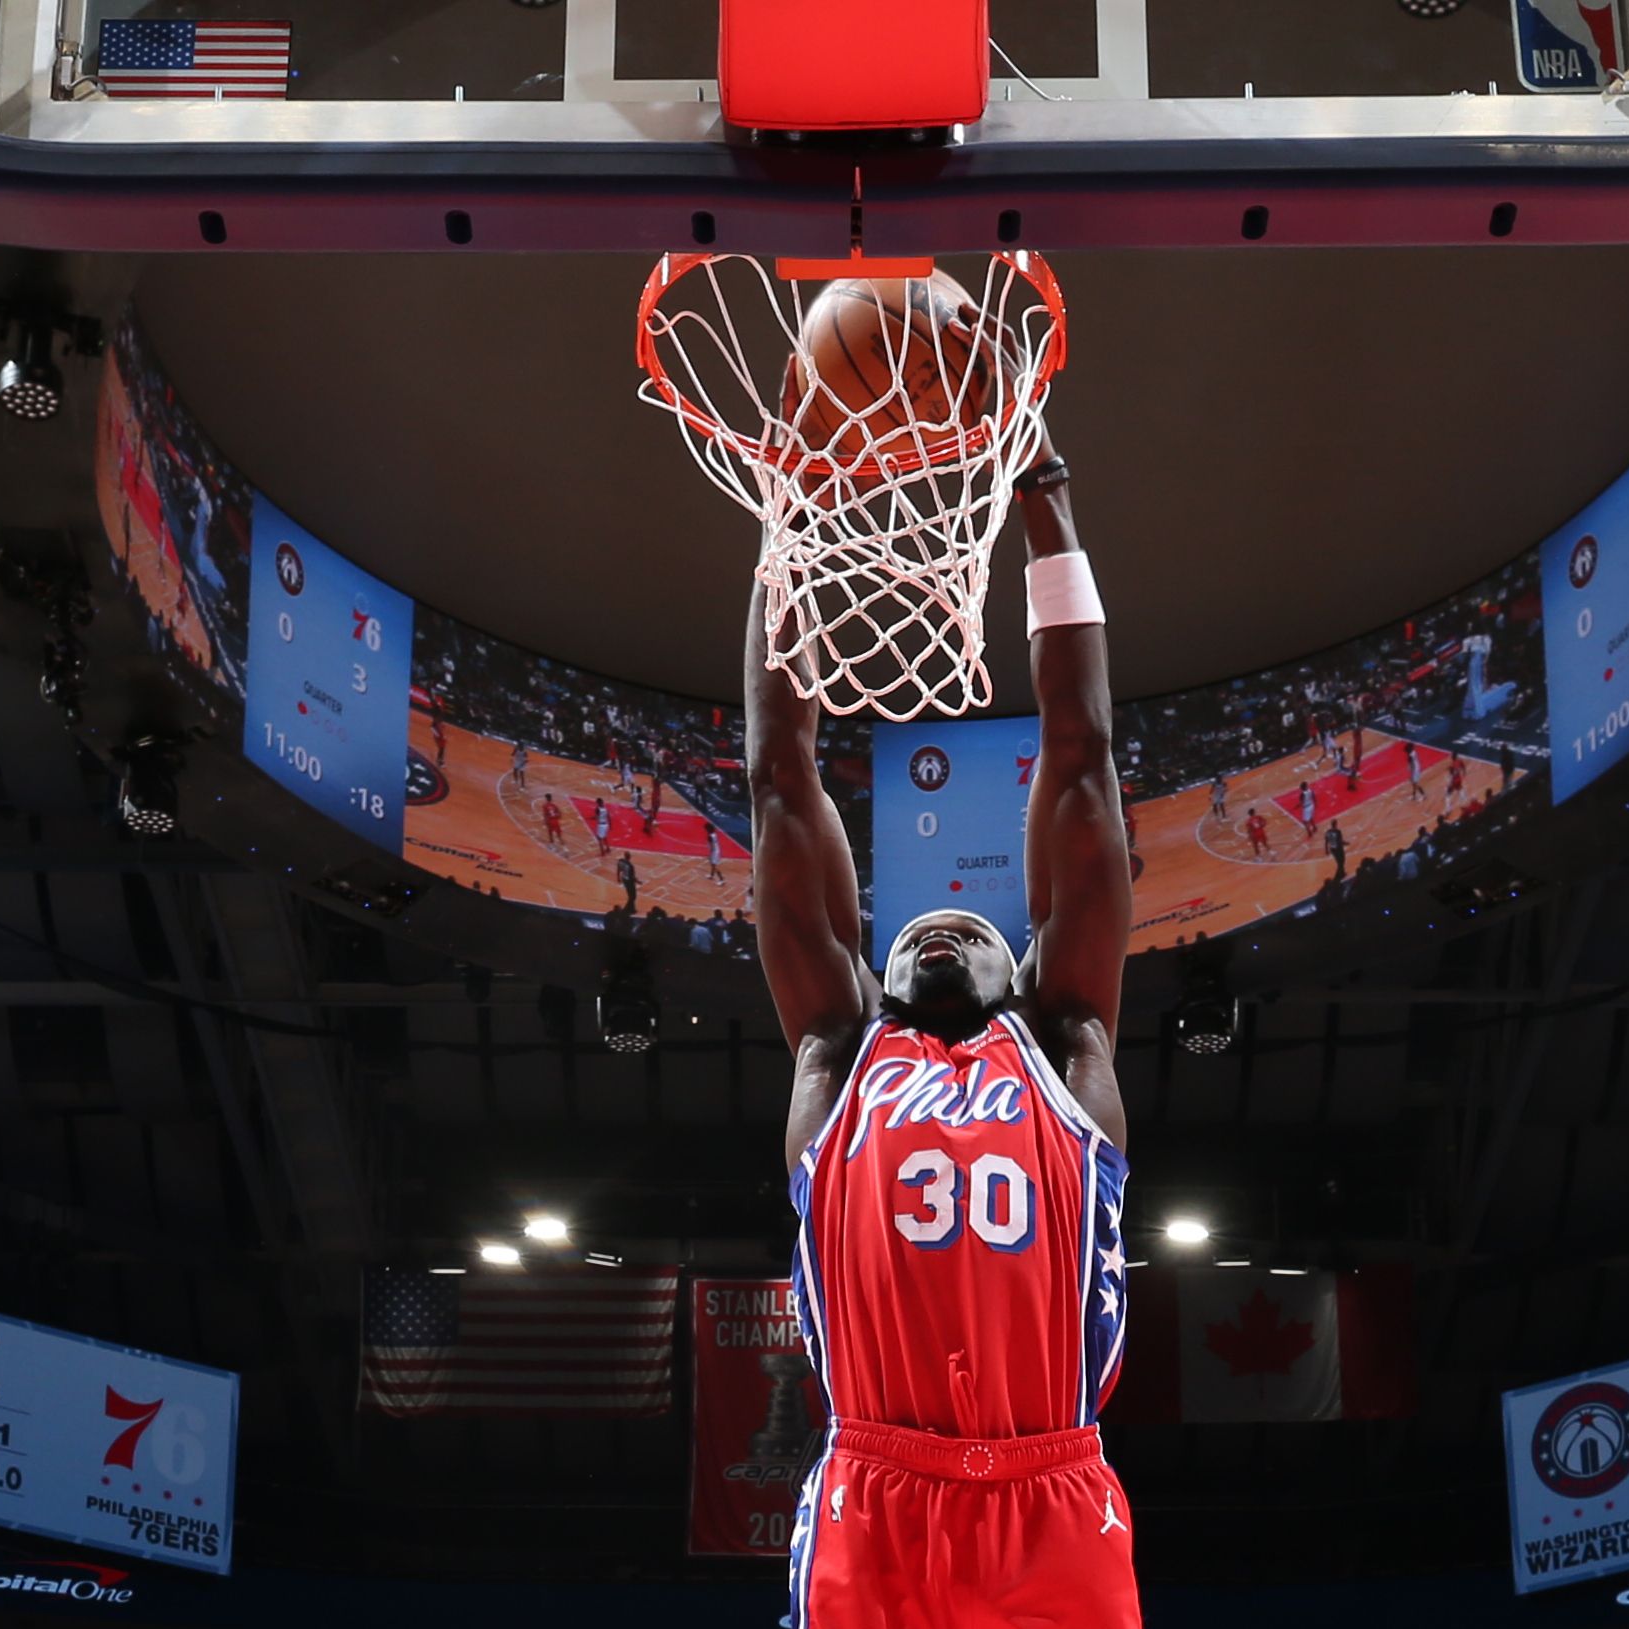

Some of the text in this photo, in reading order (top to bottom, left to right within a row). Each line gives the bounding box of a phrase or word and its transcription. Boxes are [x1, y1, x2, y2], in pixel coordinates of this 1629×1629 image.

[1532, 48, 1582, 79] NBA
[279, 612, 294, 643] 0
[351, 608, 381, 651] 76
[1577, 607, 1593, 638] 0
[352, 663, 367, 694] 3
[264, 722, 322, 782] 11:00
[351, 786, 385, 819] :18
[916, 811, 939, 838] 0
[956, 855, 1010, 871] QUARTER
[846, 1056, 1027, 1161] Phila
[893, 1148, 1036, 1254] 30
[705, 1288, 796, 1317] STANLE
[715, 1320, 803, 1348] CHAMP
[103, 1383, 206, 1485] 76
[86, 1495, 220, 1538] PHILADELPHIA
[748, 1512, 795, 1547] 20
[128, 1518, 219, 1556] 76ERS
